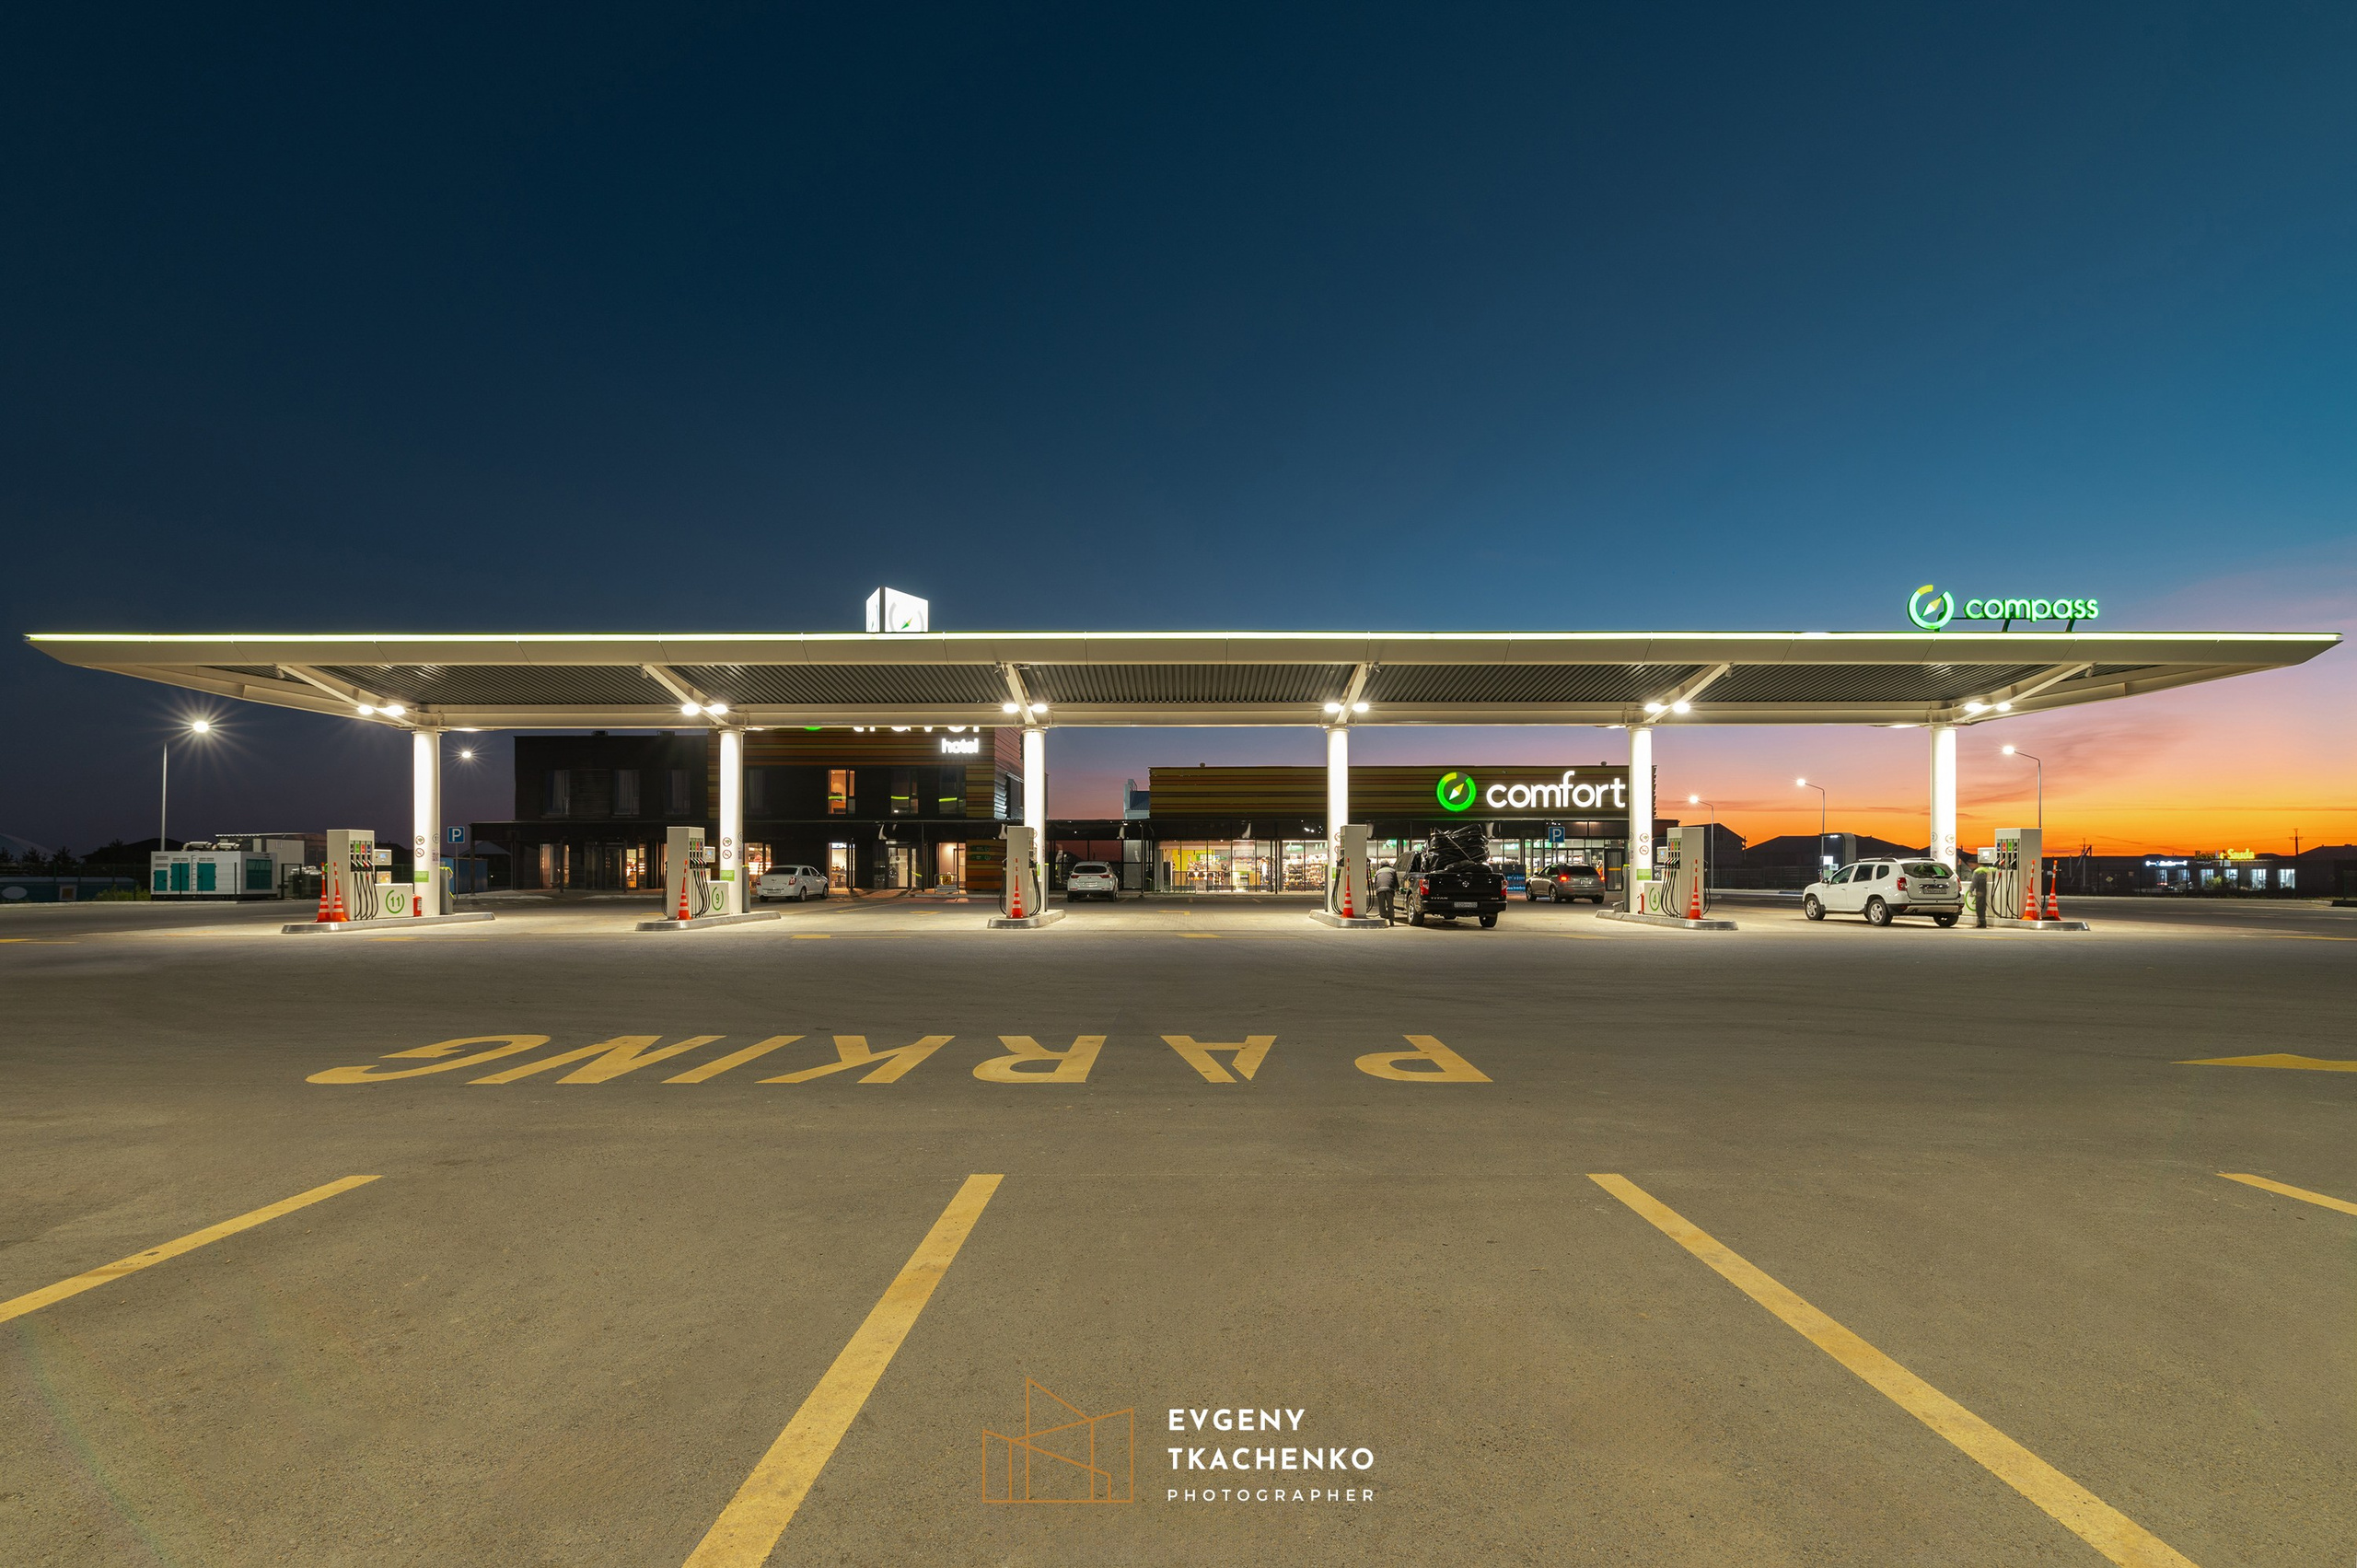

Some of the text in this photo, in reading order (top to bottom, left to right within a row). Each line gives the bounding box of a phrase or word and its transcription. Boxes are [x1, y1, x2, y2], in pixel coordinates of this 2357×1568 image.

[1964, 598, 2099, 622] compass
[941, 738, 980, 754] hotel
[1486, 770, 1626, 808] comfort
[389, 896, 401, 907] 11
[715, 893, 720, 904] 9
[305, 1034, 1494, 1085] PARKING
